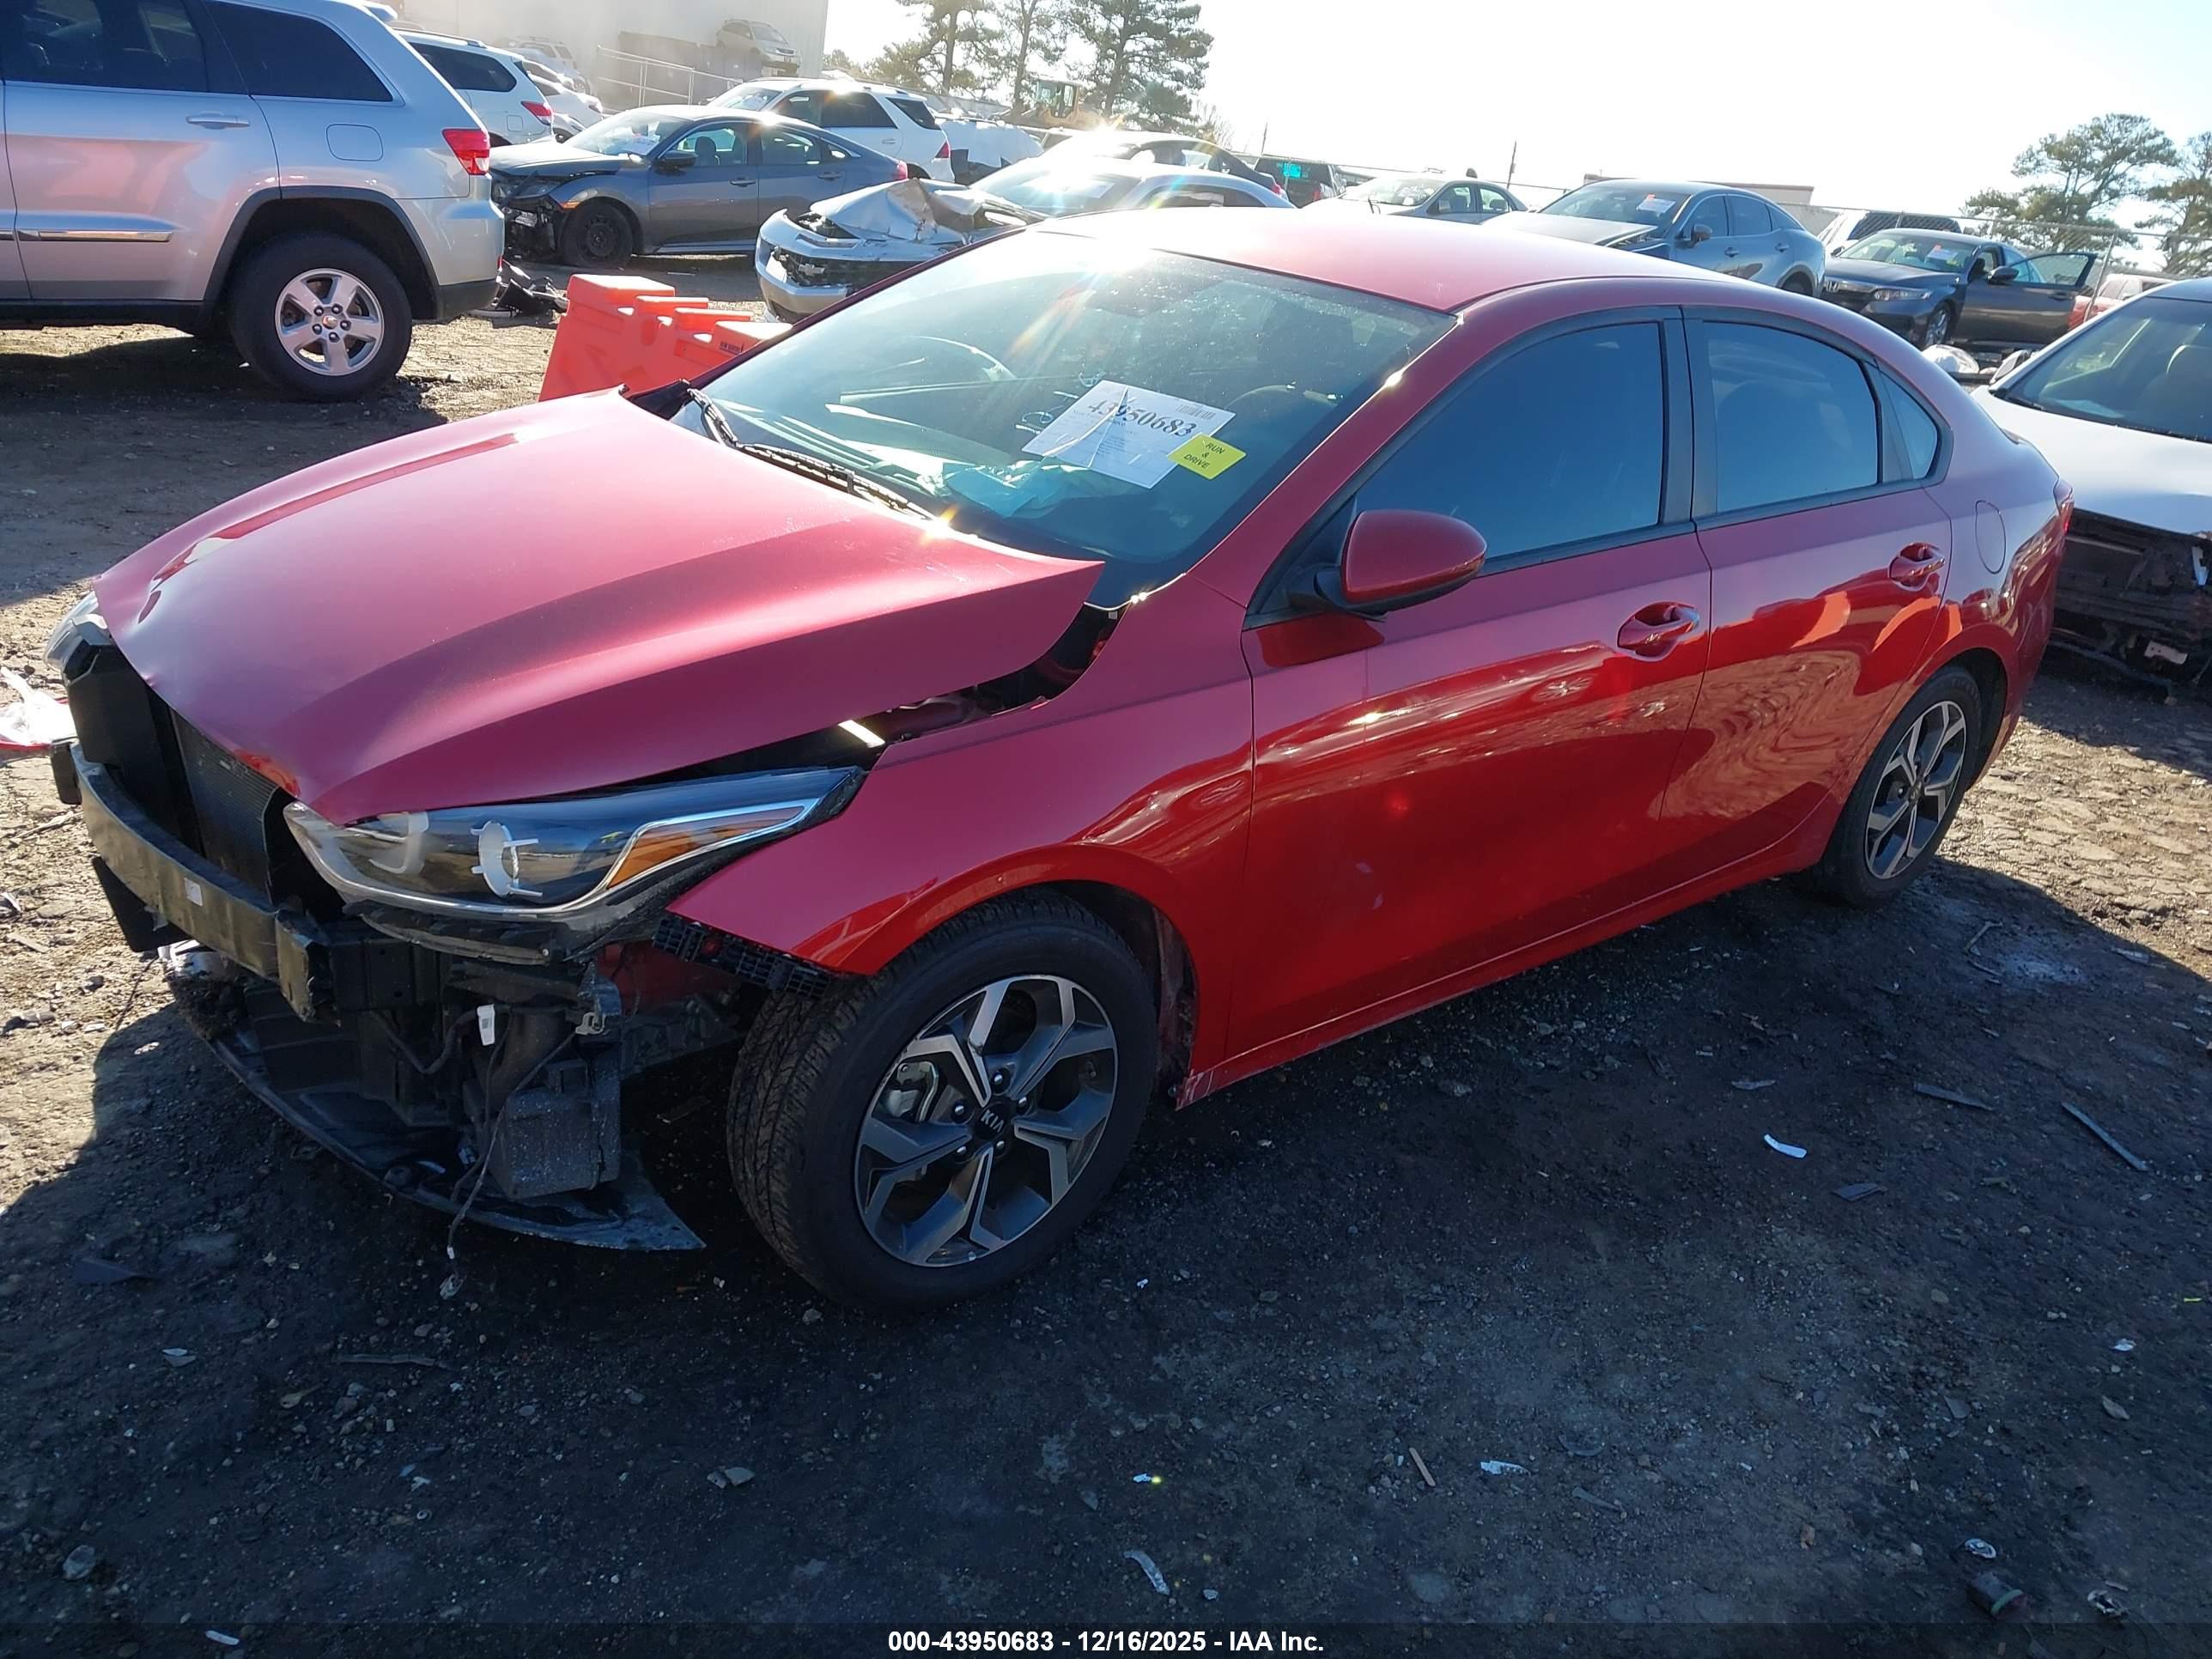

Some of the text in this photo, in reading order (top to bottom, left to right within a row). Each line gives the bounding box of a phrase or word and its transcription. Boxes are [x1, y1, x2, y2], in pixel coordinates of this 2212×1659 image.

[1205, 441, 1226, 454] RUN
[1183, 453, 1210, 469] DRIVE
[980, 1109, 1005, 1133] KIA
